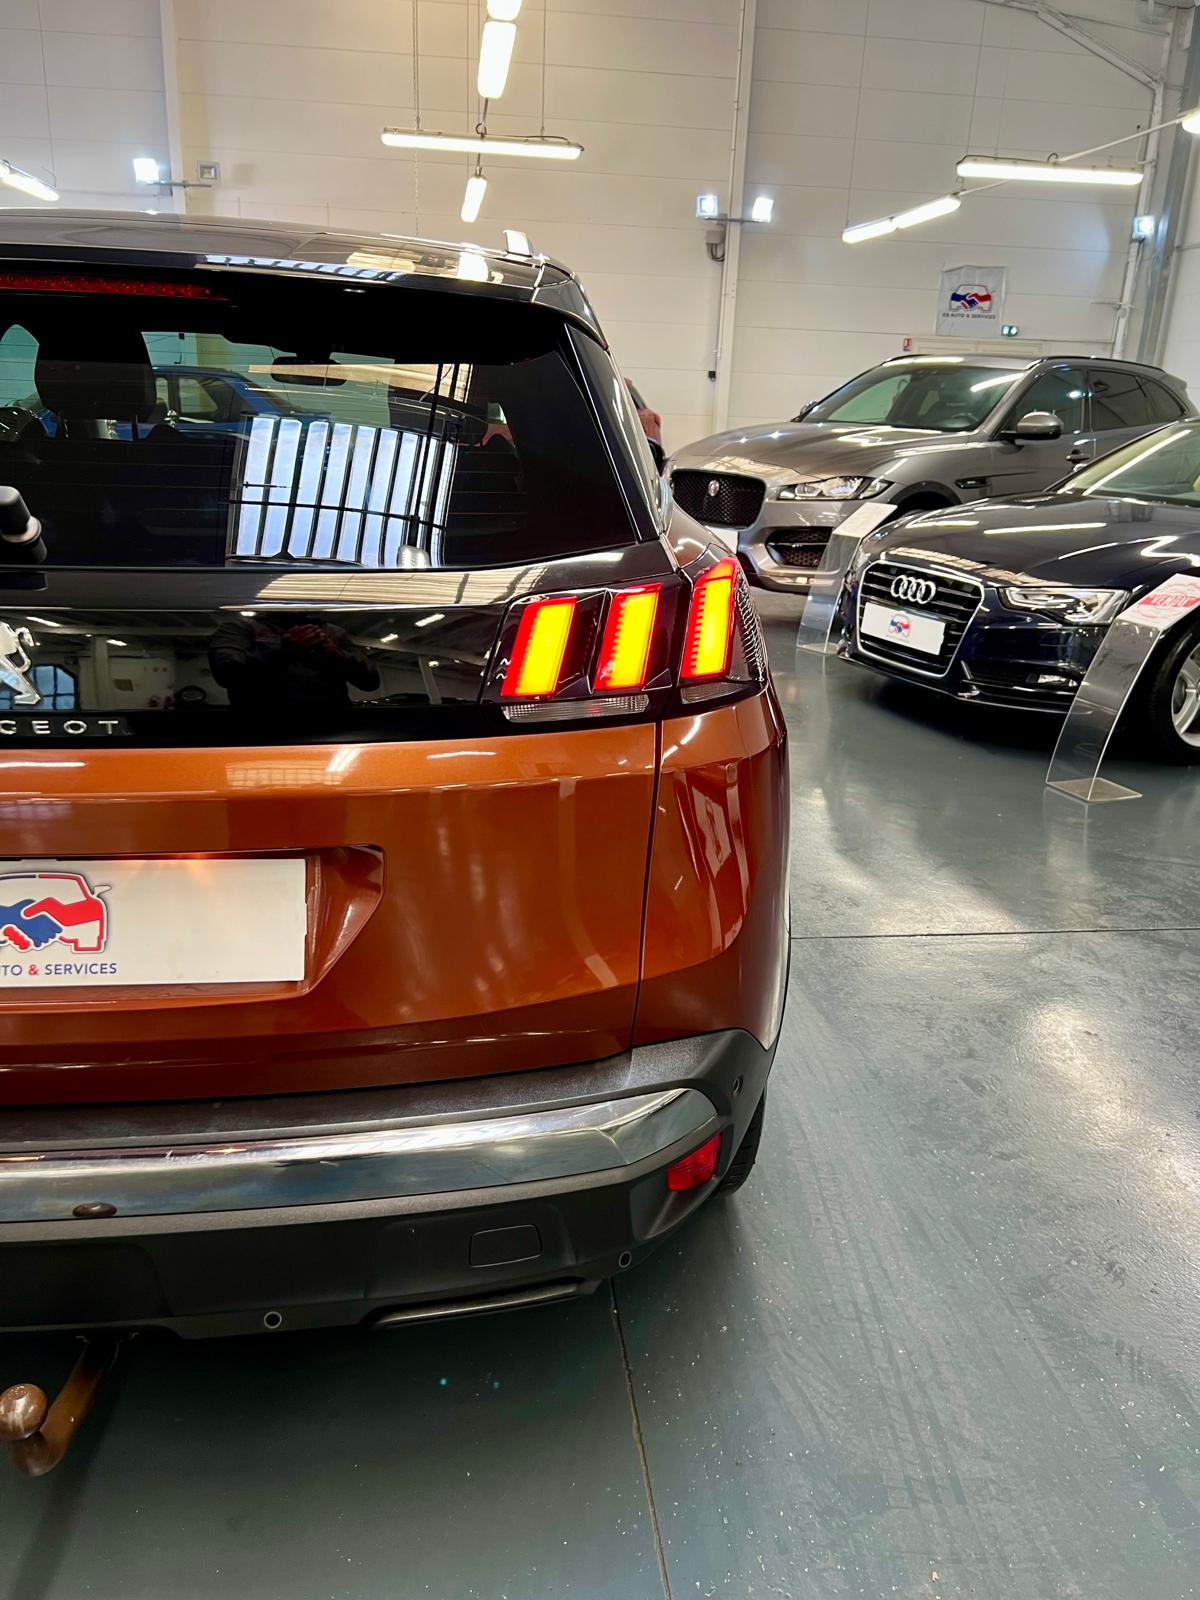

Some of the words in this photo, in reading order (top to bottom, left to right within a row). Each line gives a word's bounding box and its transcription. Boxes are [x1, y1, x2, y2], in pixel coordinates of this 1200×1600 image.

[0, 720, 118, 734] GEOT
[28, 964, 39, 976] &
[45, 963, 117, 975] SERVICES
